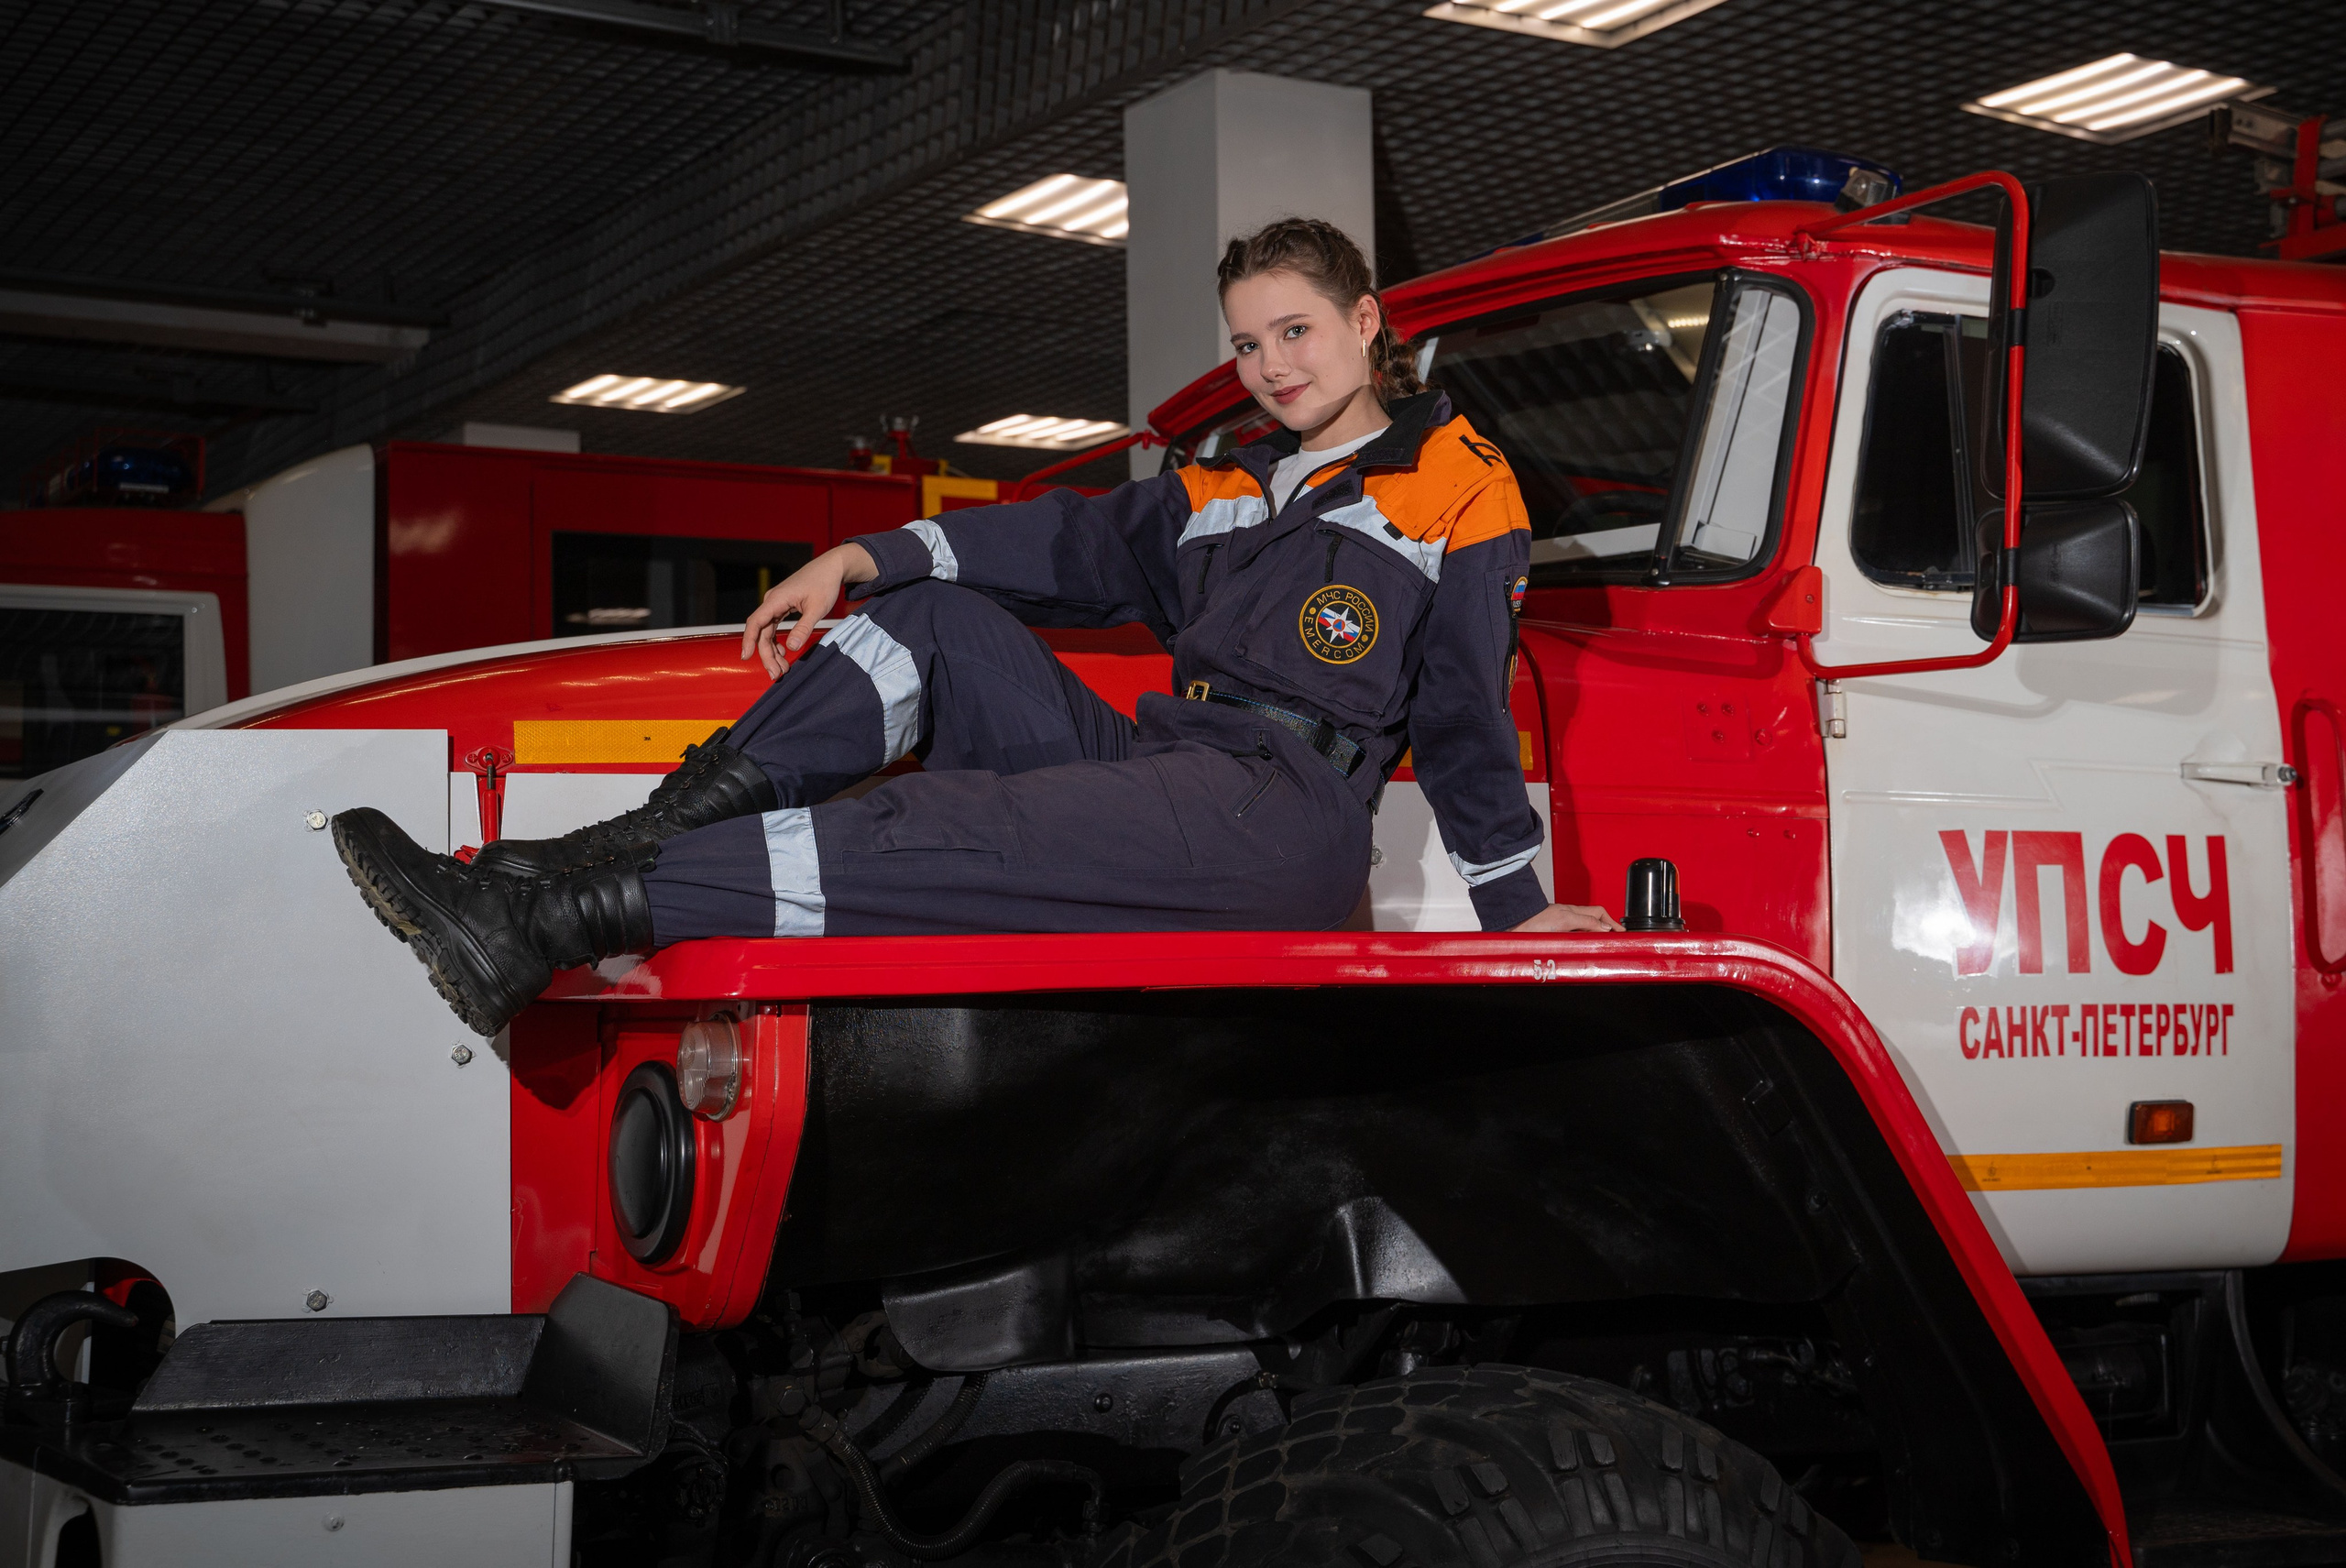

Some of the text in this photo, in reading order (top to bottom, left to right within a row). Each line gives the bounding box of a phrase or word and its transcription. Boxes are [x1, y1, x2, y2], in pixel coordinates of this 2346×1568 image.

[1316, 590, 1375, 632] МЧС РОССИИ
[1304, 616, 1365, 659] EMERCOM
[1937, 829, 2233, 975] УПСЧ
[1533, 959, 1556, 983] 5,2
[1959, 1003, 2233, 1060] САНКТ-ПЕТЕРБУРГ
